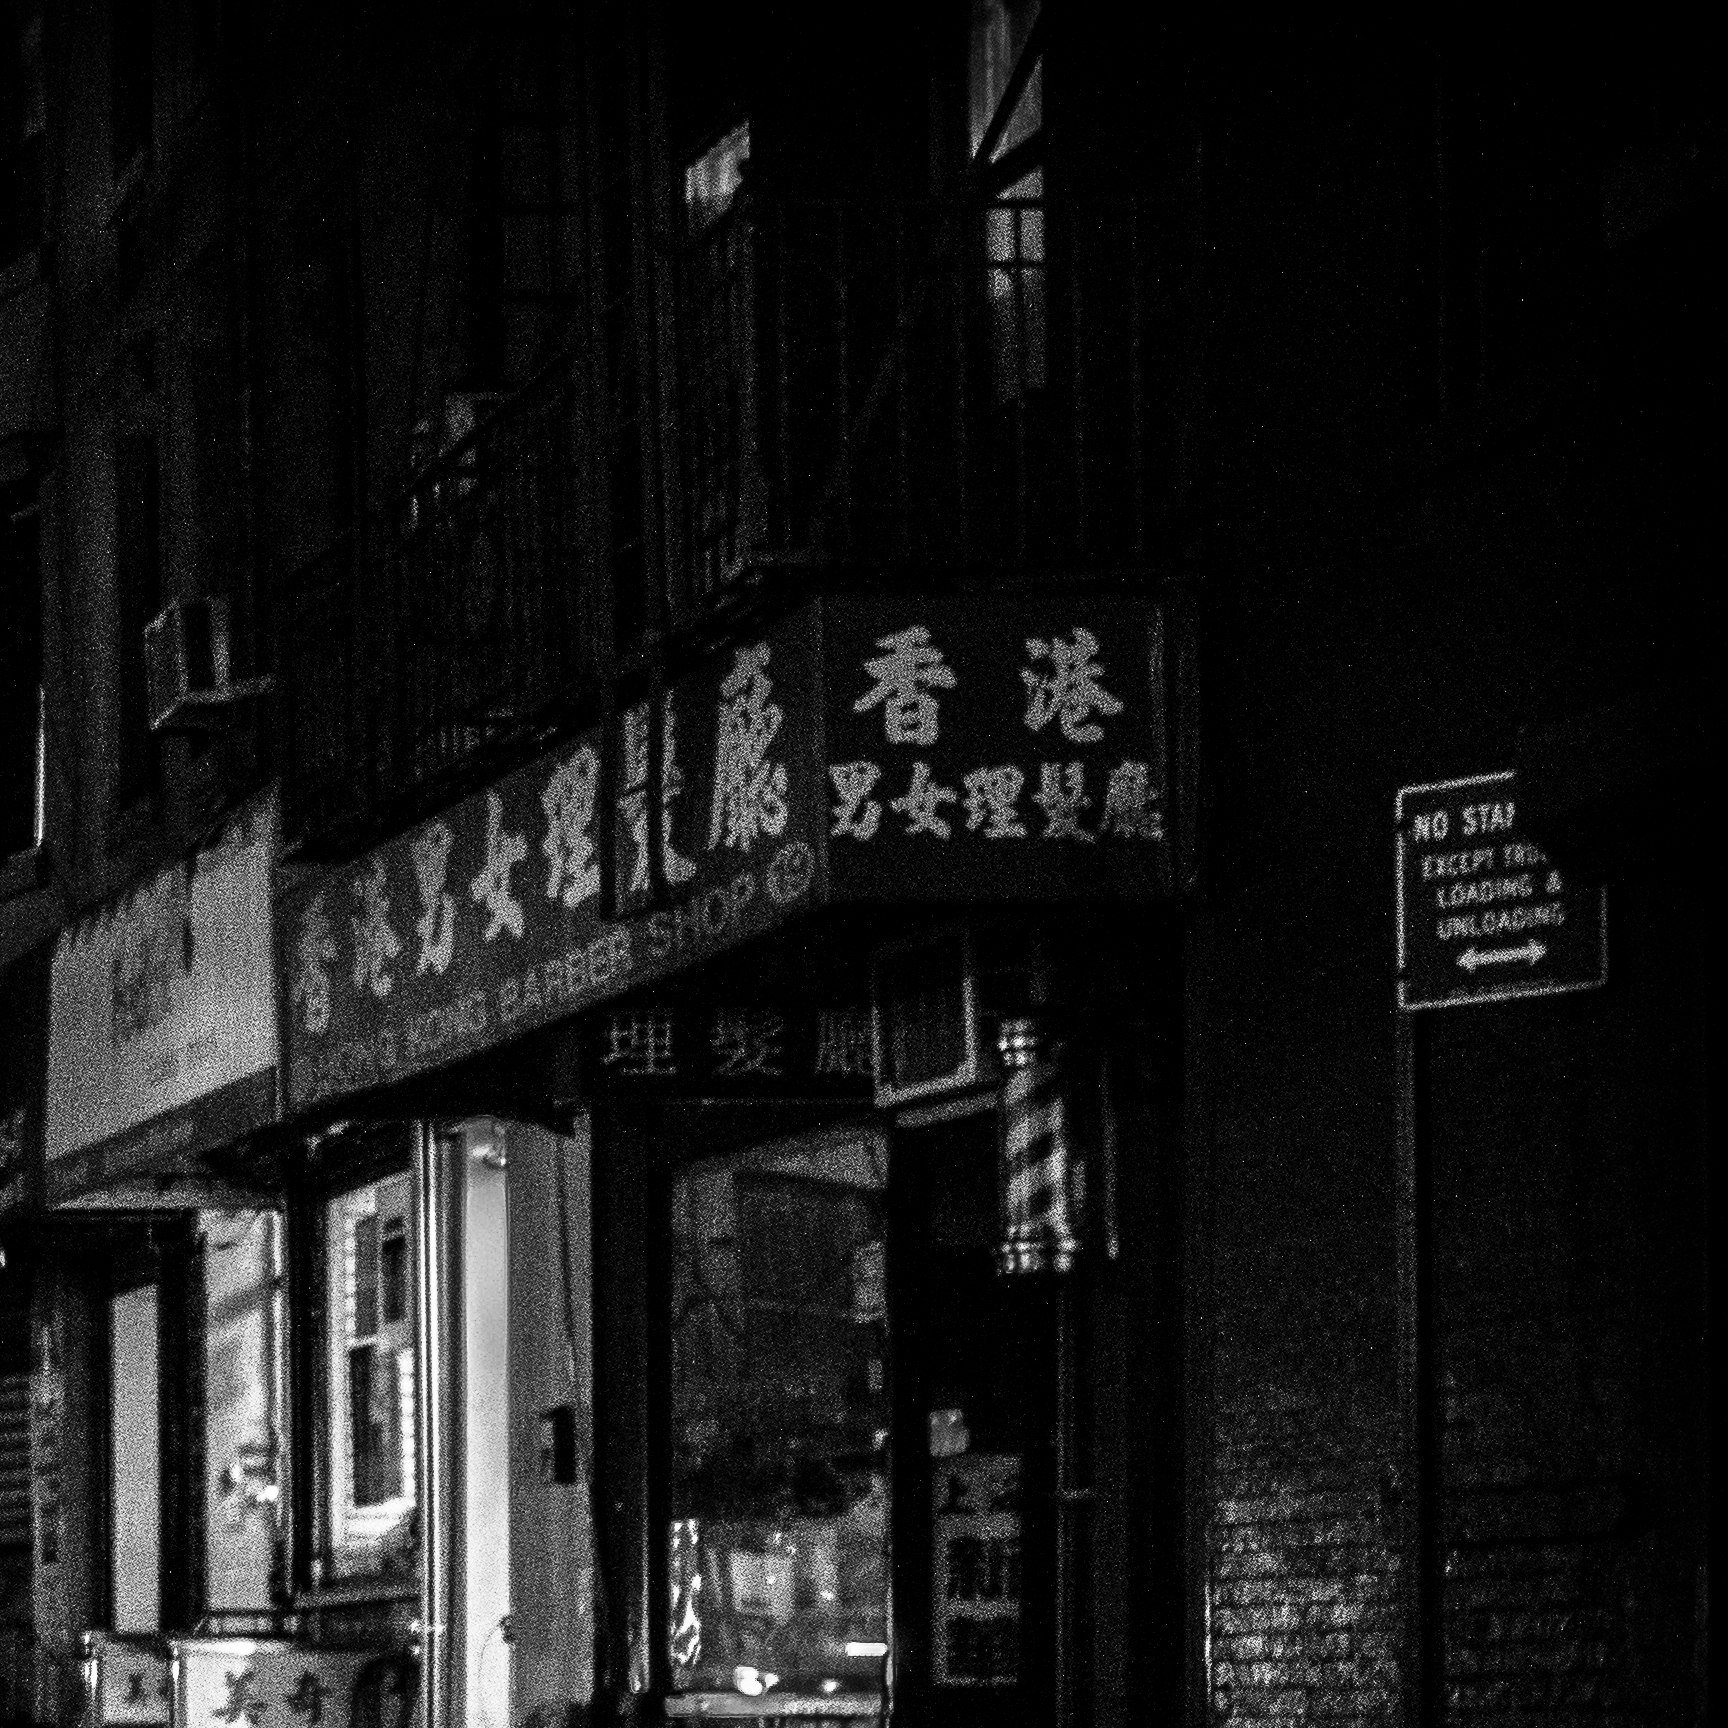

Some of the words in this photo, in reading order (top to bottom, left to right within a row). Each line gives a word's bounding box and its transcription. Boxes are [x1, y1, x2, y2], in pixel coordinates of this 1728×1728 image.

[852, 624, 1125, 746] 香港
[1413, 809, 1449, 843] NO
[1421, 849, 1495, 881] EXCEPT
[1437, 873, 1533, 910] LOADING
[1545, 868, 1564, 895] &
[499, 925, 634, 1023] BARBER
[646, 870, 758, 960] SHOP
